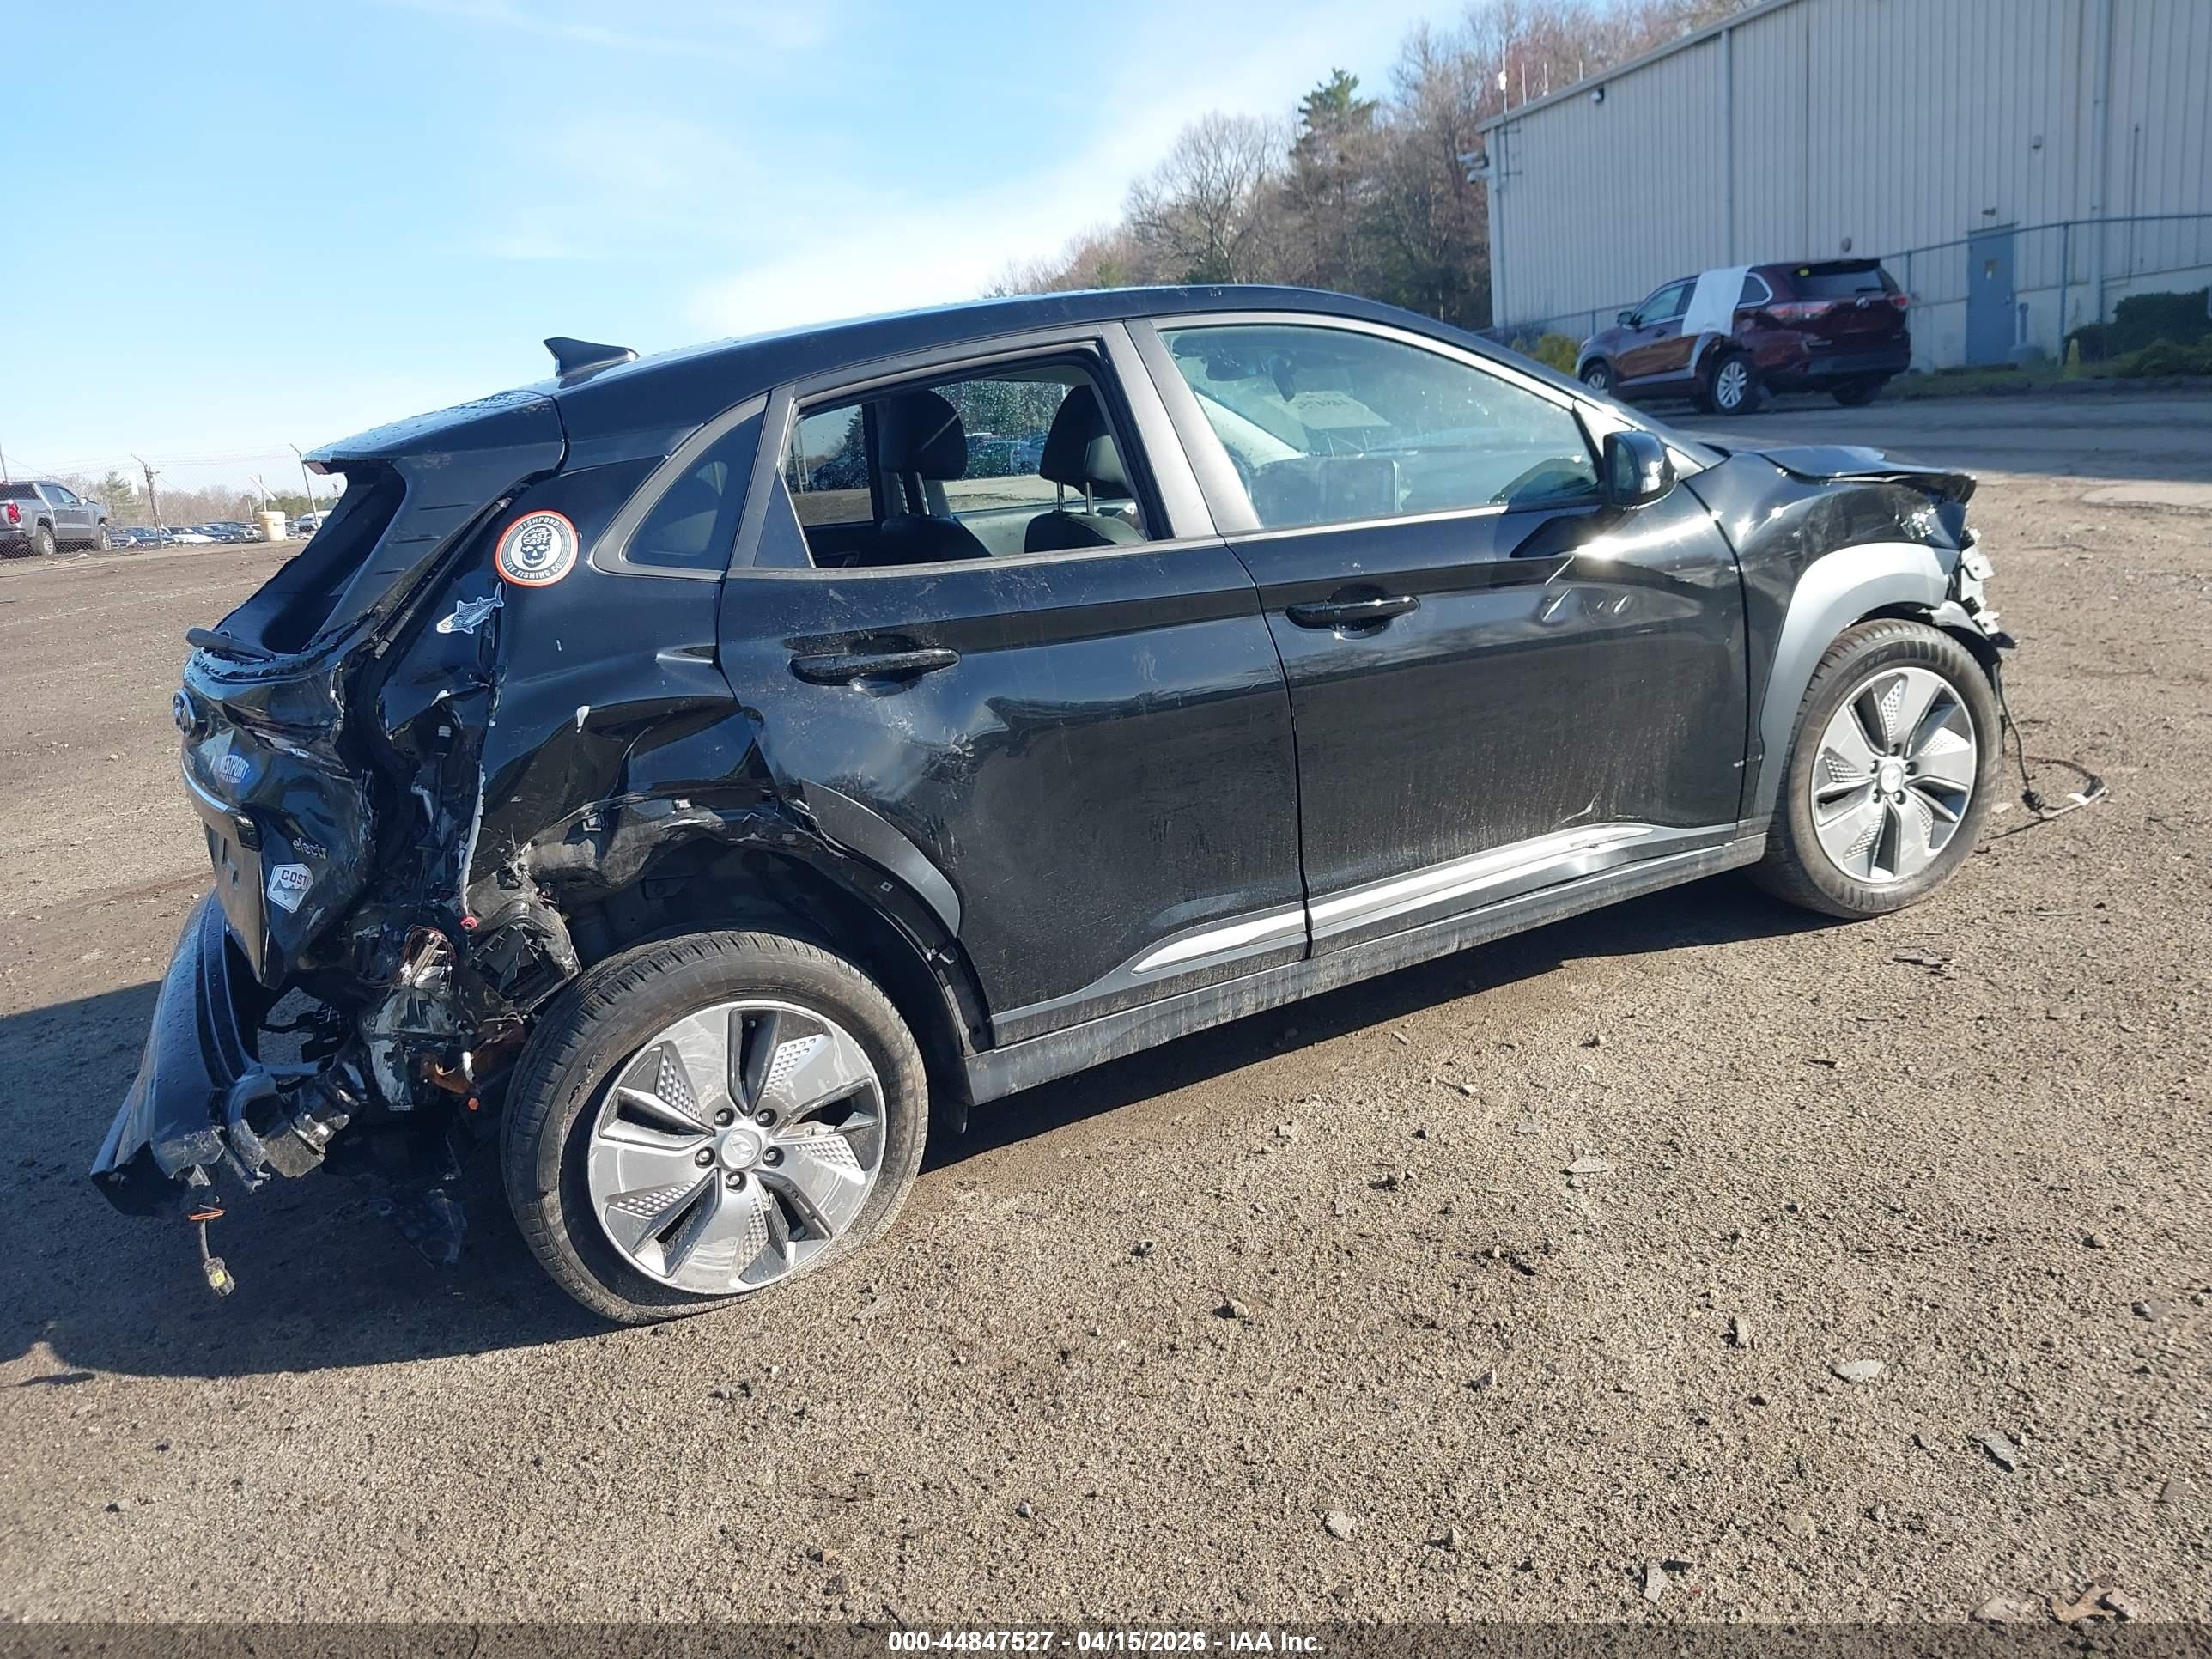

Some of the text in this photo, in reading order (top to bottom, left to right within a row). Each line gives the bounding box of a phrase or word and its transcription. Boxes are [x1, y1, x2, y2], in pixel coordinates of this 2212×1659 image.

[519, 516, 560, 531] FISHPOND
[505, 562, 517, 572] FLY
[515, 569, 551, 580] FISHING
